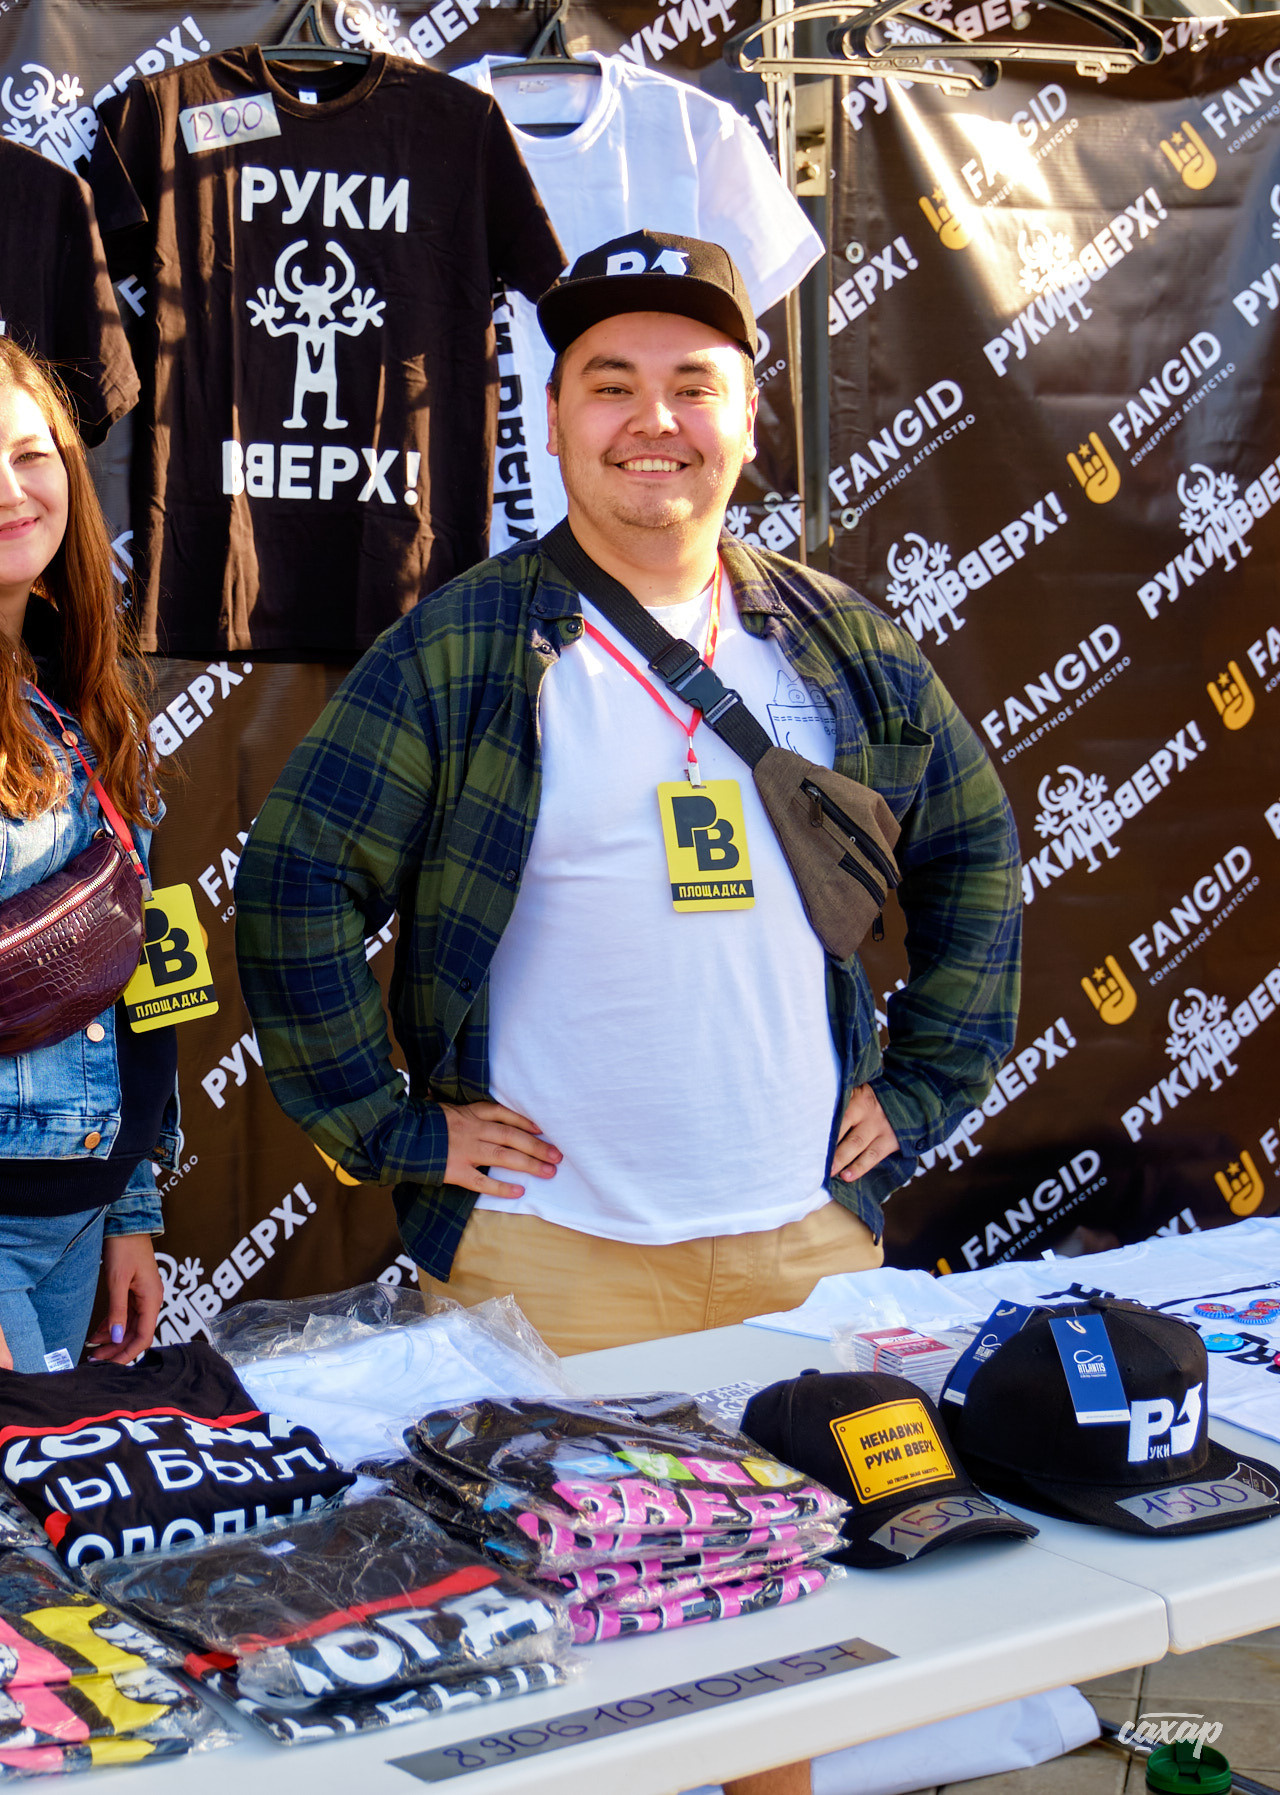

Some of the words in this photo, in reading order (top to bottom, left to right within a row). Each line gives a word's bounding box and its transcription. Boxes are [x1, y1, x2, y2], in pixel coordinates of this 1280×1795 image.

[187, 101, 263, 144] 1200
[240, 166, 410, 233] РУКИ
[1108, 331, 1221, 451] FANGID
[1129, 409, 1183, 467] КОНЦЕРТНОЕ
[1180, 362, 1236, 420] АГЕНТСТВО
[222, 440, 421, 506] ВВЕРХ!
[828, 379, 964, 506] FANGID
[854, 463, 913, 518] ОНЦЕРТНОЕ
[913, 413, 976, 466] АГЕНТСТВО
[980, 624, 1121, 749] FANGID
[1001, 705, 1074, 764] КОНЦЕРТНОЕ
[1075, 655, 1131, 709] АГЕНТСТВО
[678, 883, 747, 899] ПЛОЩАДКА
[1128, 846, 1252, 972] FANGID
[1148, 926, 1212, 988] КОНЦЕРТНОЕ
[1211, 875, 1260, 930] АГЕНТСТВО
[135, 991, 209, 1019] ПЛОЩАДКА
[961, 1149, 1101, 1270] FANGID
[1045, 1176, 1108, 1227] АГЕНТСТВО
[146, 1443, 336, 1491] БЫЛ
[859, 1421, 924, 1451] НЕНАВИЖУ
[864, 1446, 903, 1470] РУКИ
[903, 1439, 937, 1458] ВВЕРХ
[890, 1500, 1000, 1546] 1500
[1142, 1484, 1249, 1518] 1500
